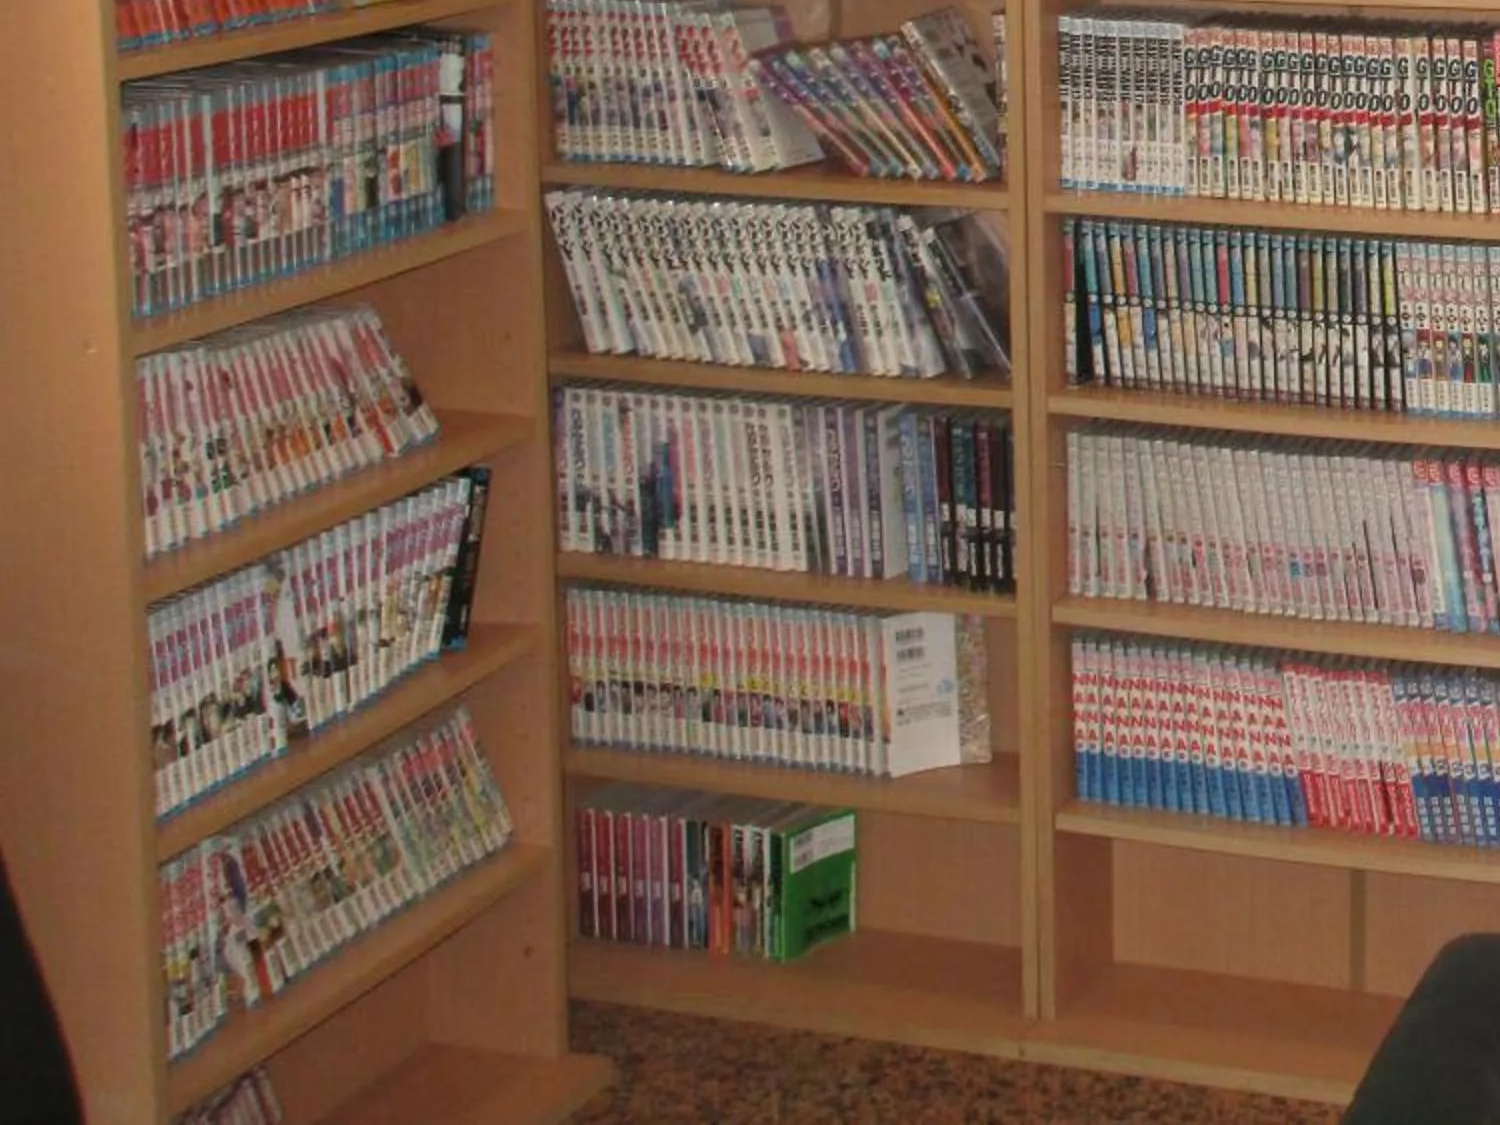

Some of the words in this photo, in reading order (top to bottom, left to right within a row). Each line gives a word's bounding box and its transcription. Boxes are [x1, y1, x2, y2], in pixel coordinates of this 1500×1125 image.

[1184, 48, 1197, 100] GTO
[1198, 48, 1211, 100] GTO
[1211, 46, 1223, 97] GTO
[1222, 48, 1236, 101] GTO
[1236, 49, 1250, 101] GTO
[1249, 50, 1258, 101] GTO
[1262, 52, 1275, 104] GTO
[1275, 51, 1287, 103] GTO
[1288, 53, 1300, 105] GTO
[1301, 53, 1314, 105] GTO
[1315, 54, 1327, 106] GTO
[1328, 56, 1341, 109] GTO
[1342, 56, 1357, 109] GTO
[1355, 56, 1367, 109] GTO
[1366, 58, 1381, 111] GTO
[1380, 58, 1393, 111] GTO
[1397, 58, 1410, 111] GTO
[1417, 57, 1429, 111] GTO
[1434, 58, 1446, 111] GTO
[1449, 59, 1462, 113] GTO
[1465, 61, 1478, 114] GTO
[1484, 59, 1496, 115] GTO
